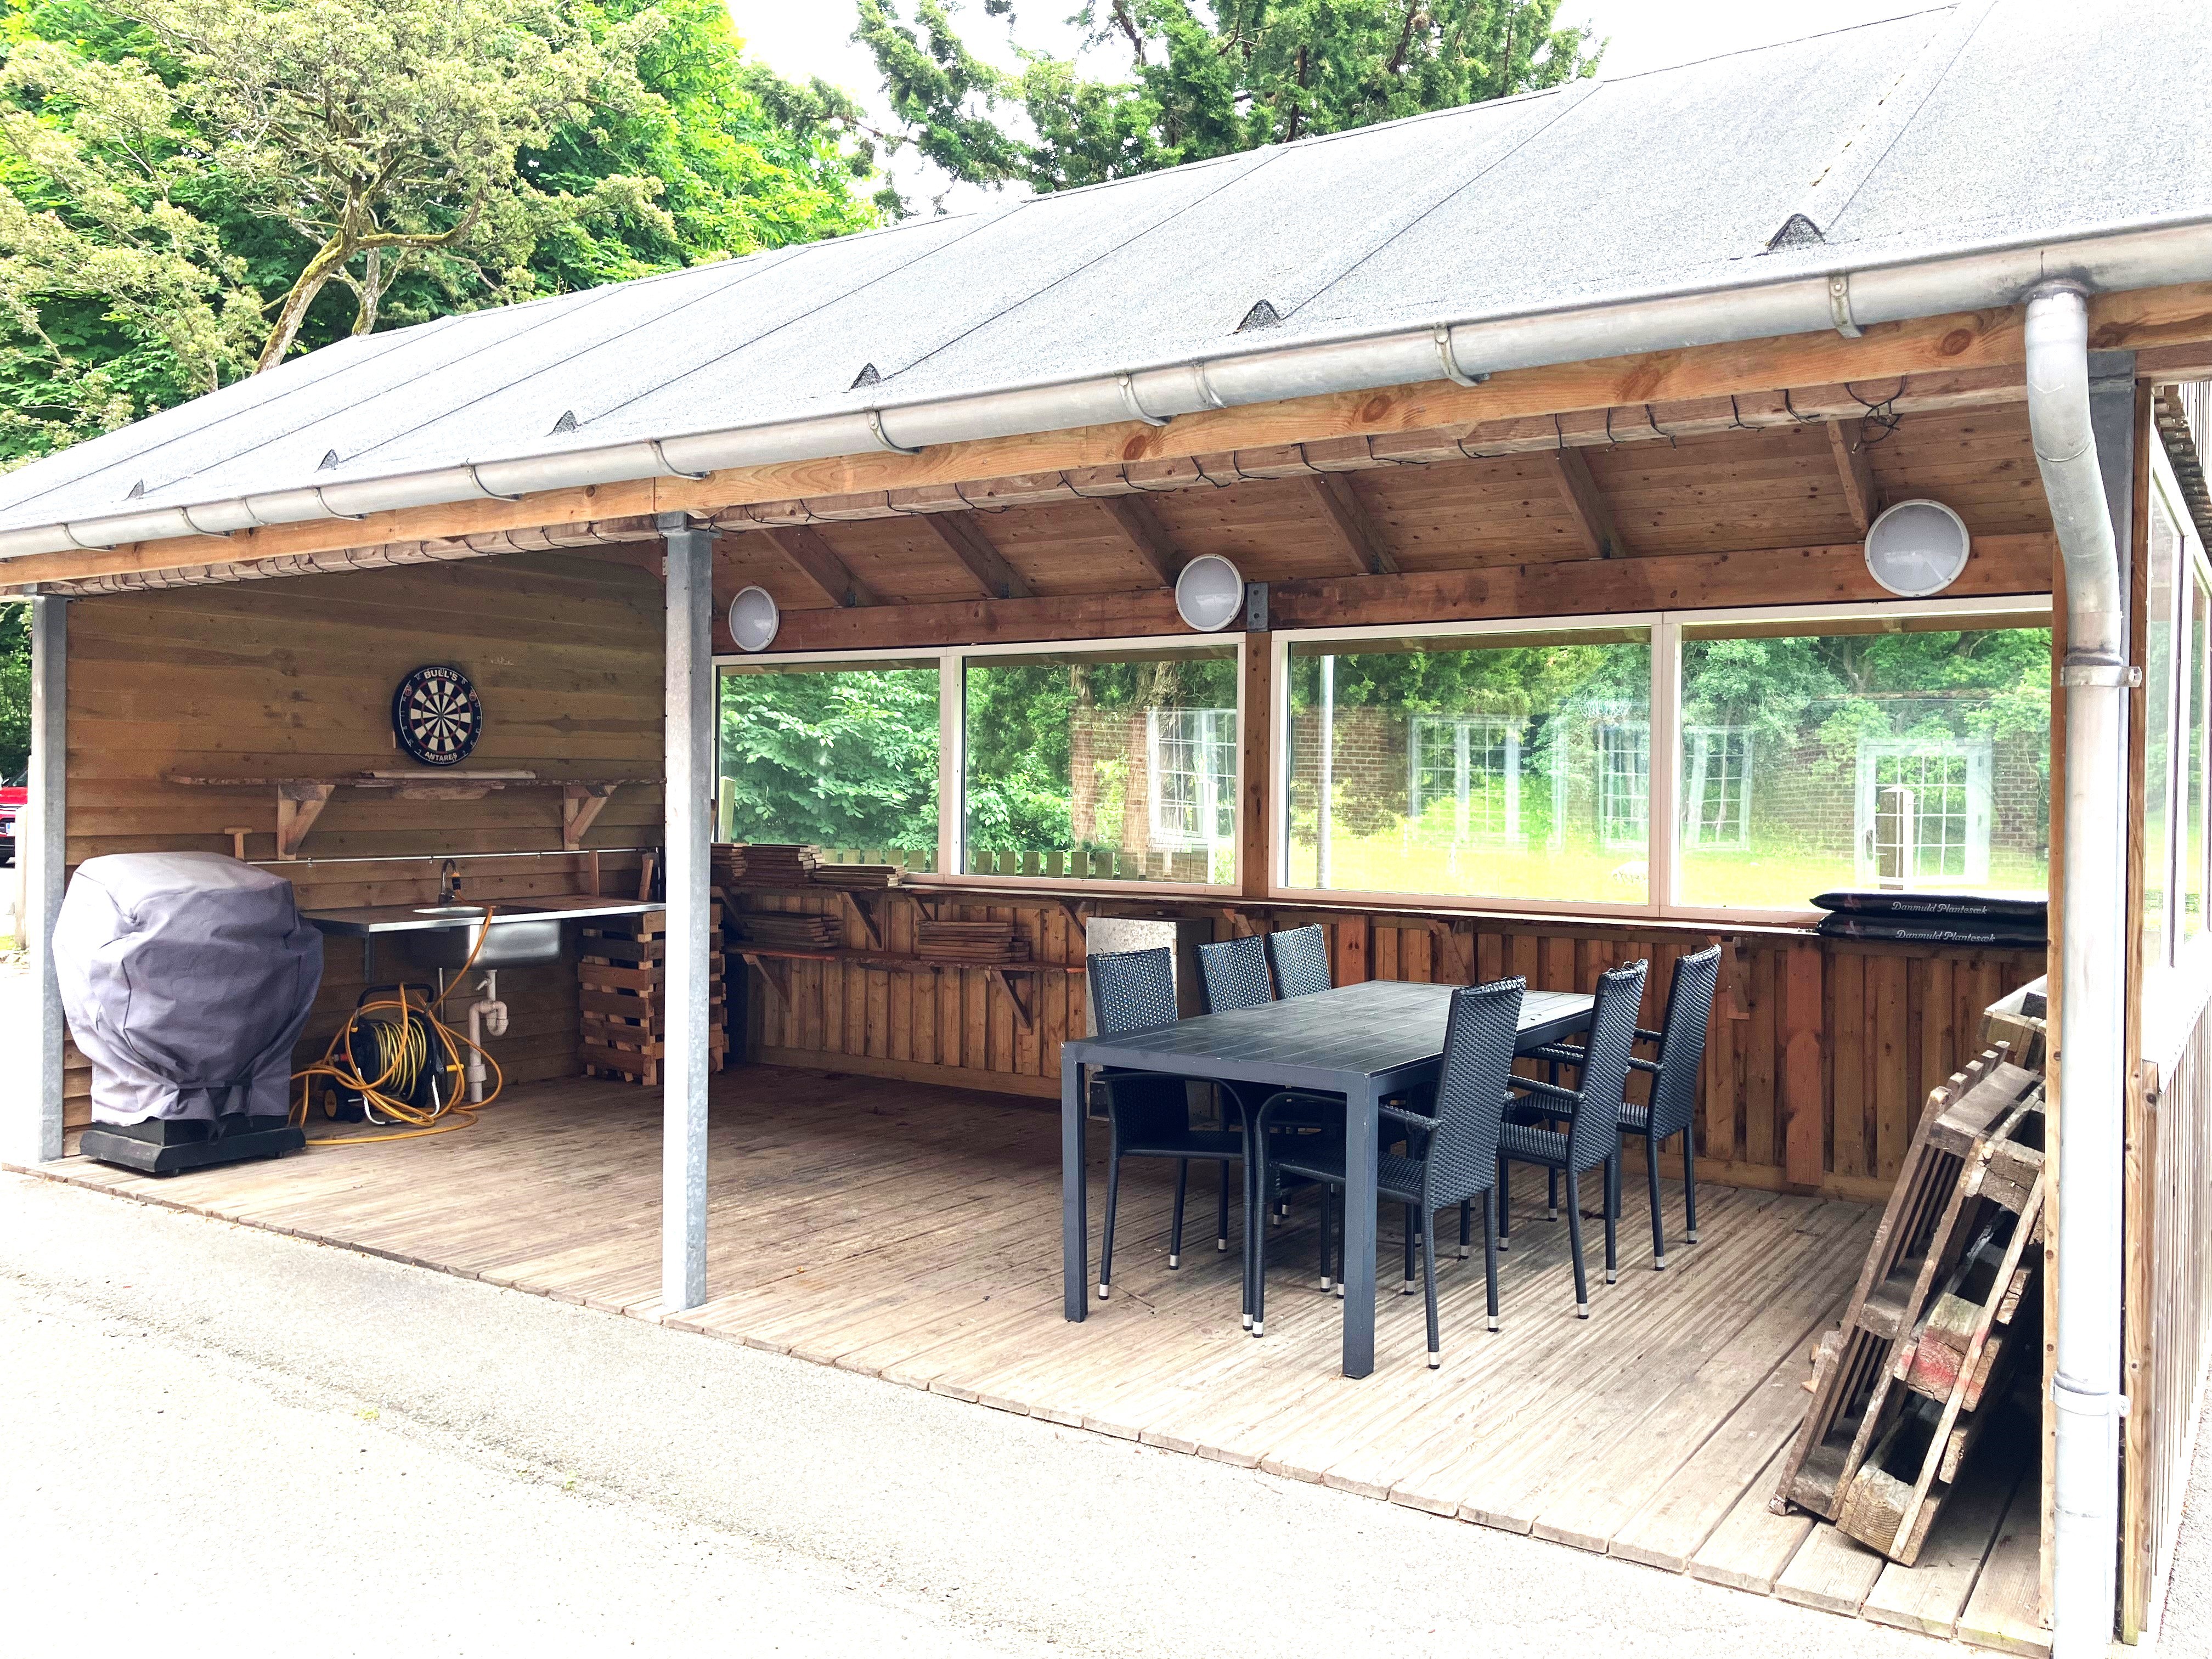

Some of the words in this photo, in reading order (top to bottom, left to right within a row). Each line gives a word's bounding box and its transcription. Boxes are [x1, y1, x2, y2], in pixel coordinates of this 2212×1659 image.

[424, 670, 458, 681] BULL'S
[425, 751, 458, 761] ANTARES
[1892, 901, 1937, 912] Danmuld
[1937, 904, 1988, 915] Plantesæk
[1895, 929, 1943, 940] Danmuld
[1943, 932, 1996, 943] Plantesæk
